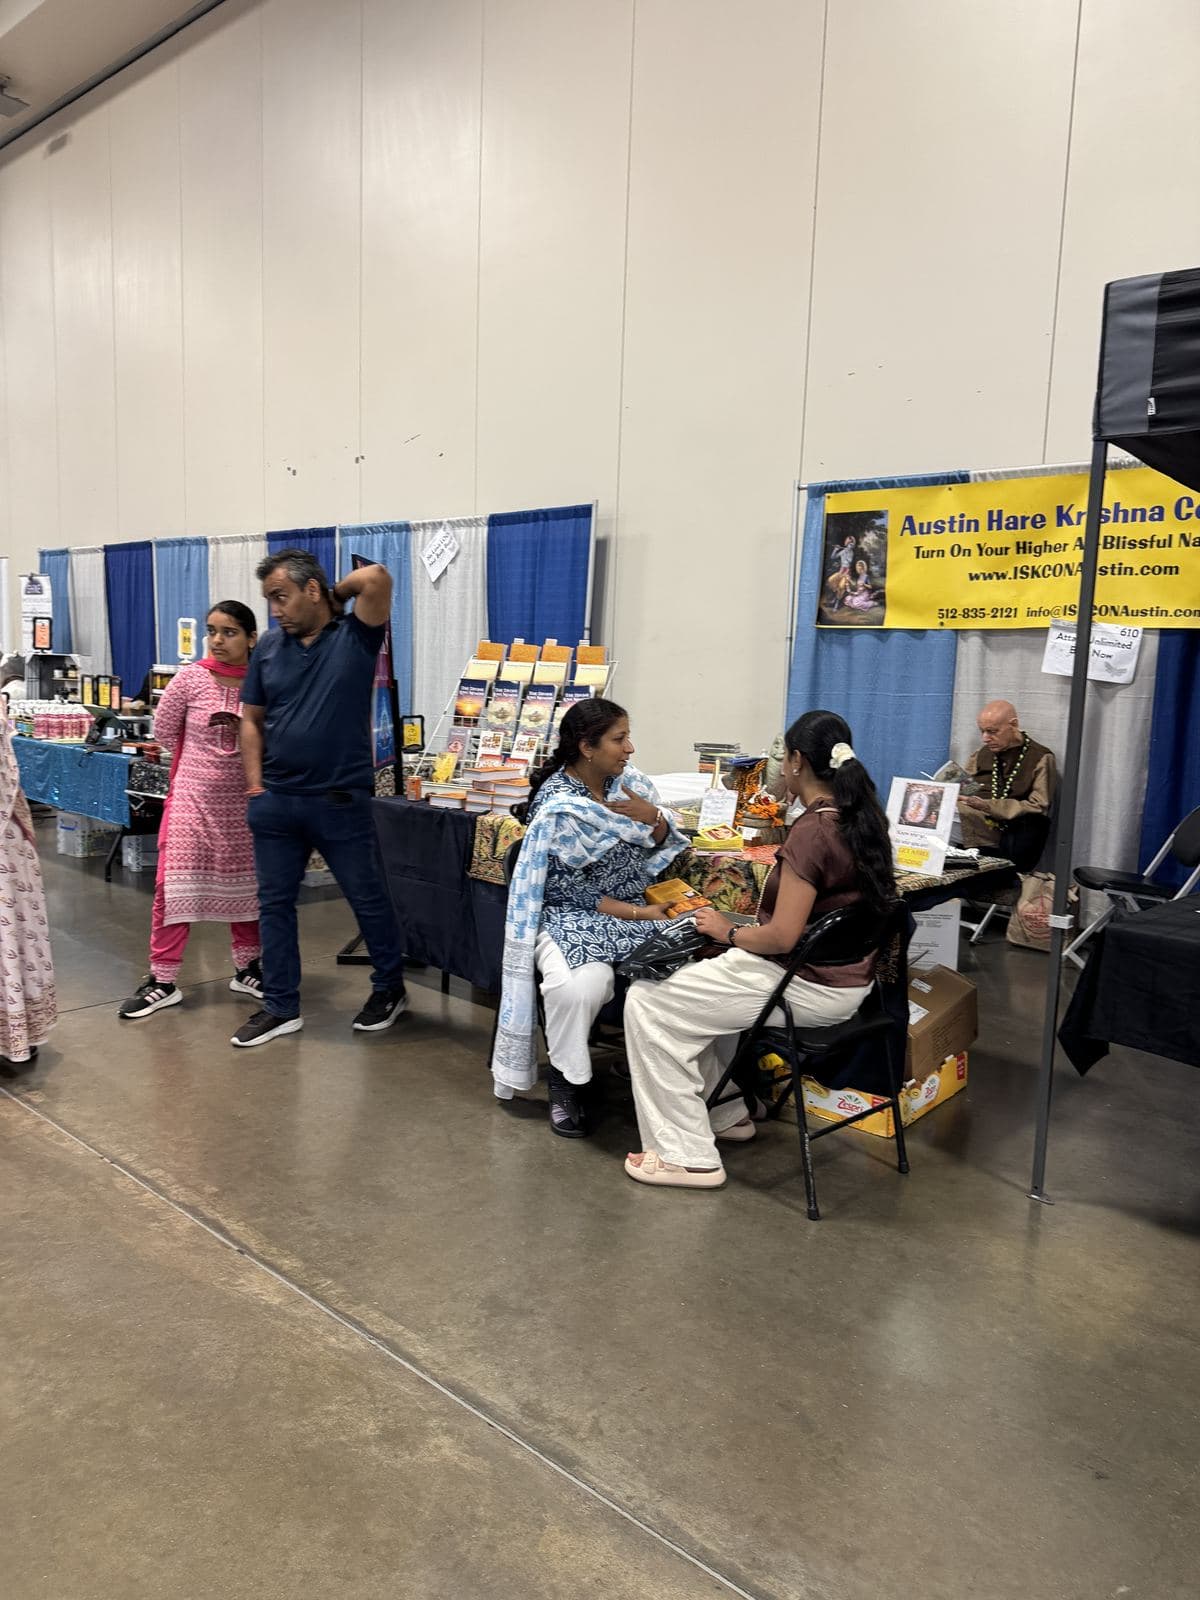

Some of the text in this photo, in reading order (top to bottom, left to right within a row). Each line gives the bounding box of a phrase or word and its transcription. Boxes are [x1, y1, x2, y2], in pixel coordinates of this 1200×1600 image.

[900, 512, 979, 536] Austin
[987, 509, 1047, 531] Hare
[1056, 502, 1165, 528] Krshna
[914, 545, 945, 559] Turn
[950, 543, 971, 558] On
[976, 542, 1010, 557] Your
[1015, 540, 1068, 557] Higher
[1073, 534, 1172, 551] A-Blissful
[968, 562, 1179, 581] www.ISKCONAstin.com
[937, 604, 1200, 619] 512-835-2121 info@ISCONAustin.co
[1120, 628, 1139, 638] 610
[1092, 649, 1114, 659] Now
